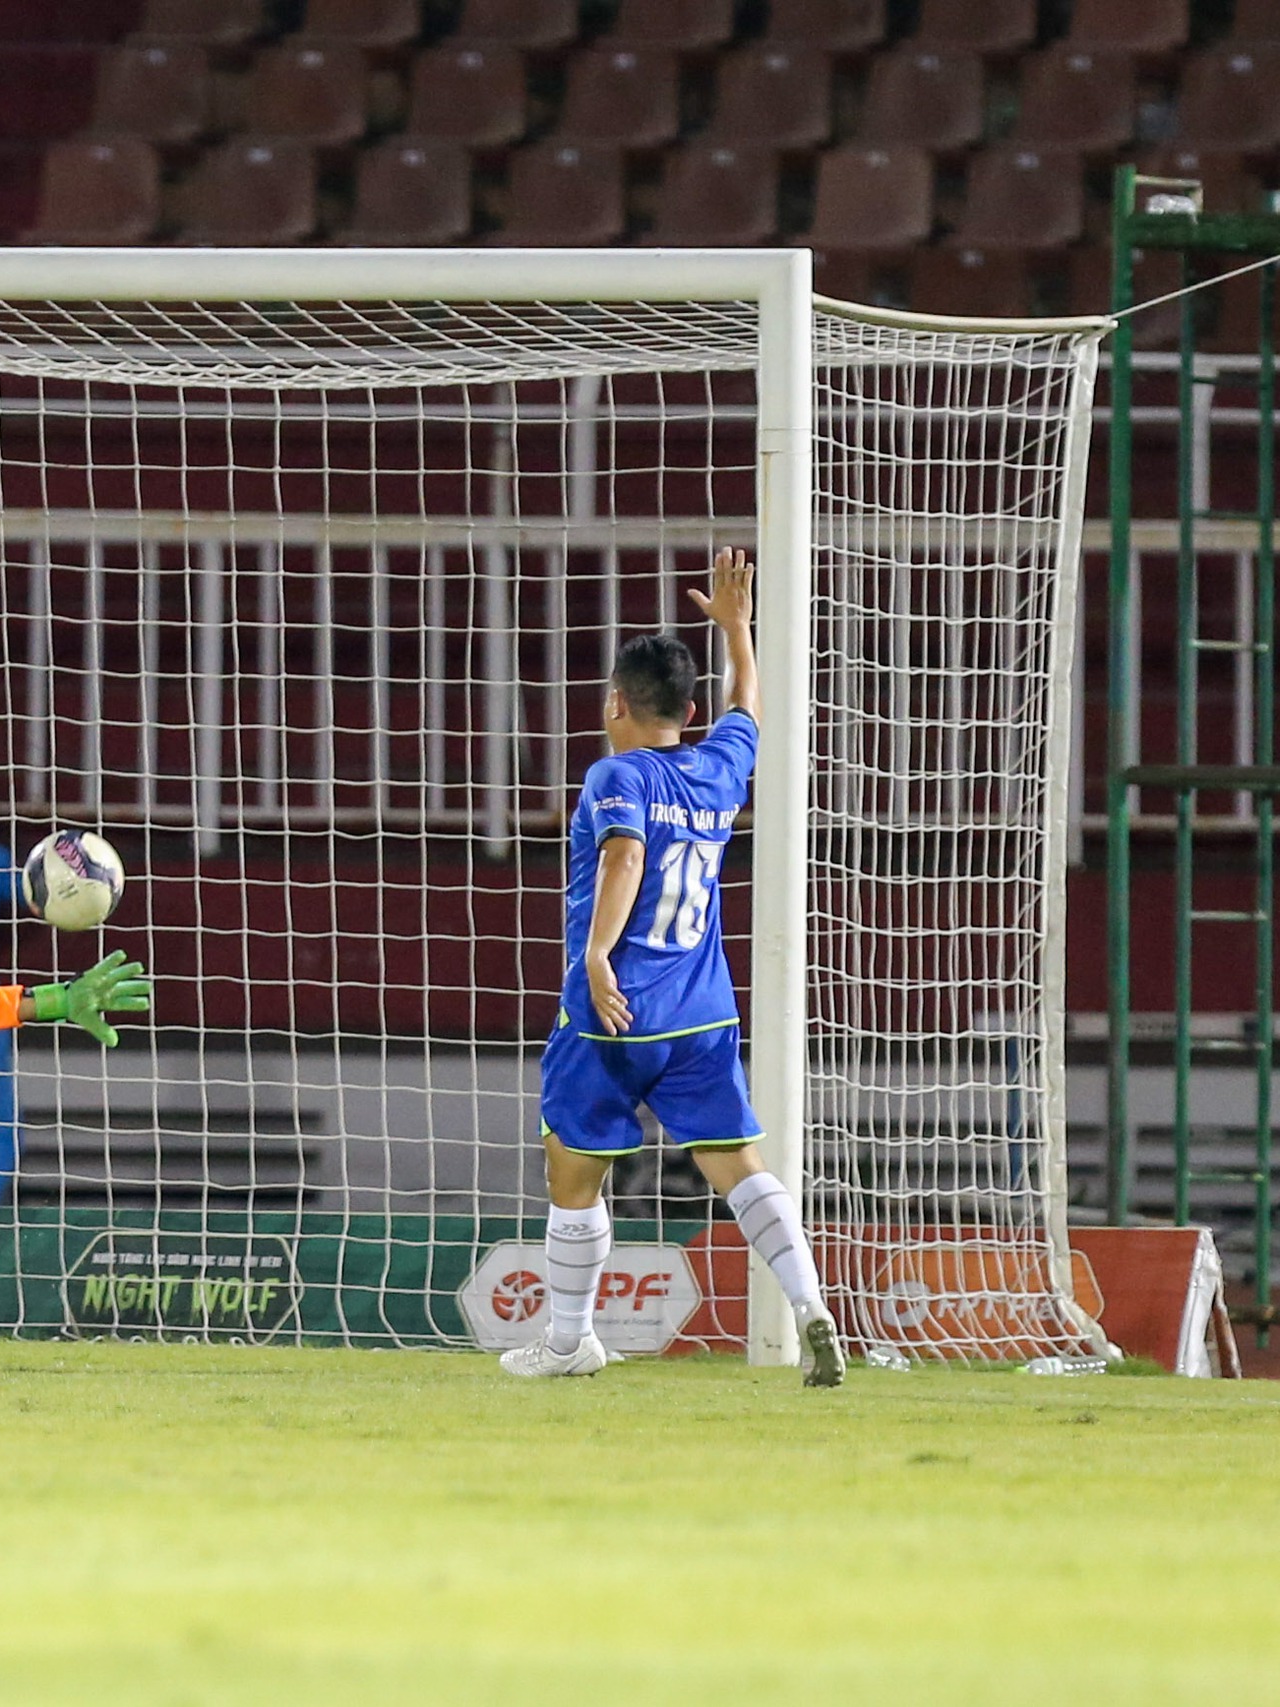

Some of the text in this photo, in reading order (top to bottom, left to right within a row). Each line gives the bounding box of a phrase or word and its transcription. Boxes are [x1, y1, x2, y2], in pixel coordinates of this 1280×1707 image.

[646, 840, 726, 949] 16
[82, 1274, 280, 1322] NIGHT WOLF
[595, 1271, 673, 1311] PF
